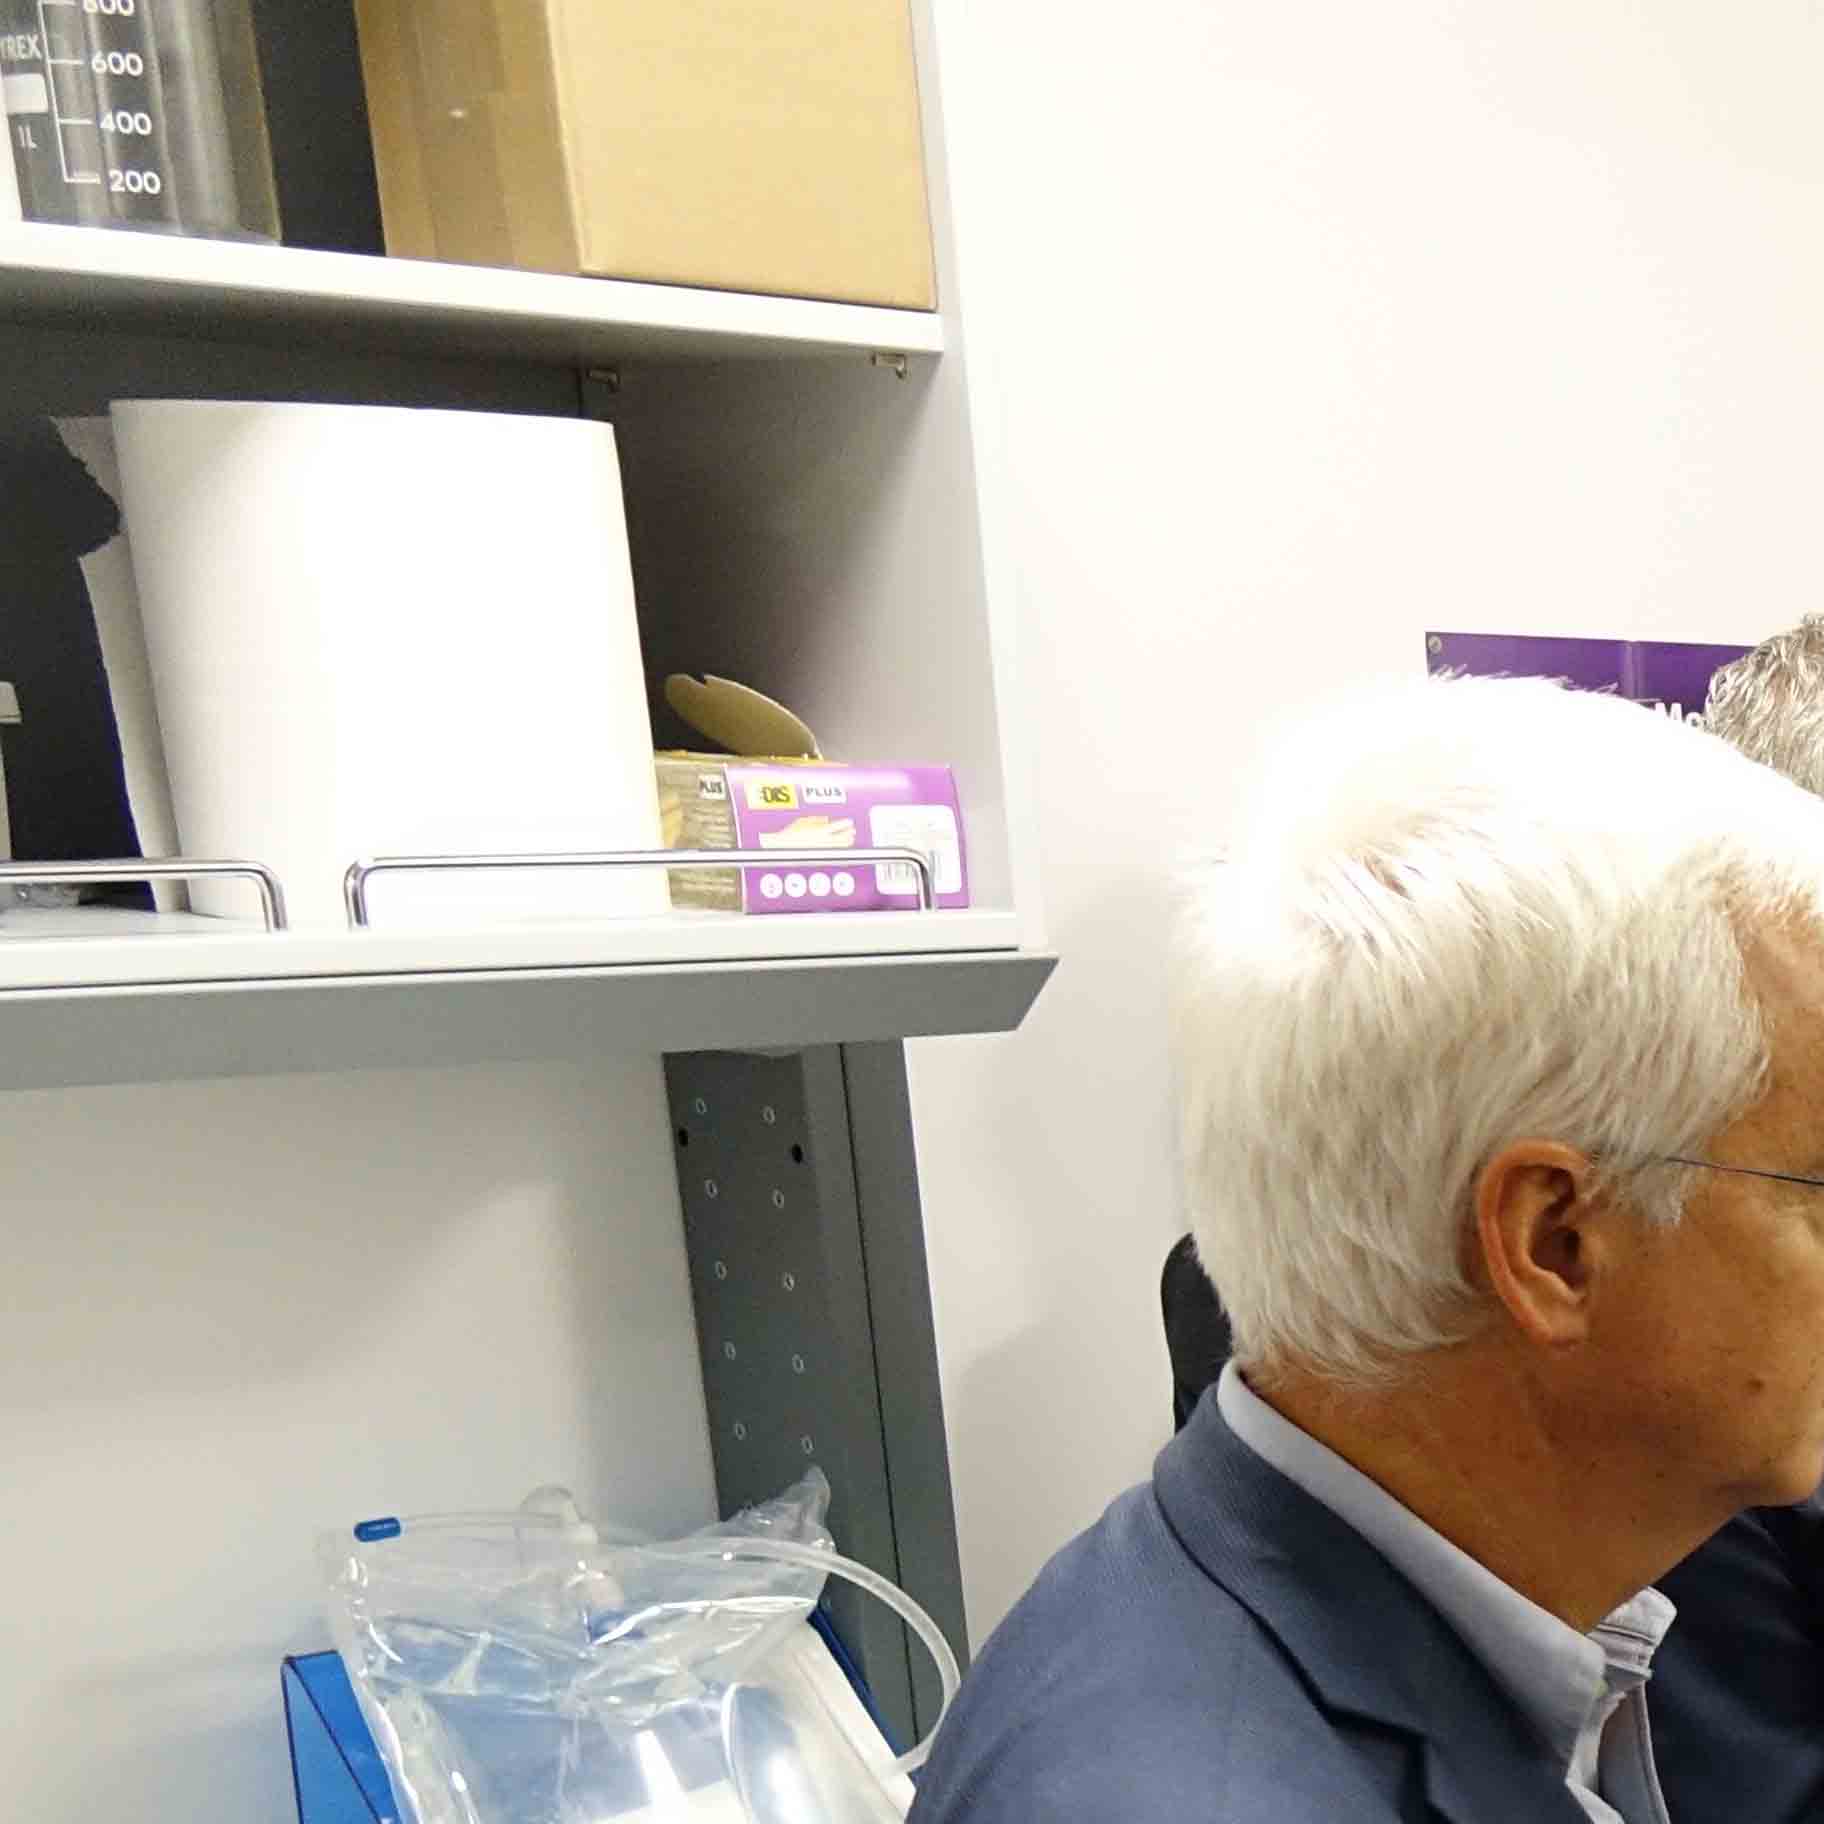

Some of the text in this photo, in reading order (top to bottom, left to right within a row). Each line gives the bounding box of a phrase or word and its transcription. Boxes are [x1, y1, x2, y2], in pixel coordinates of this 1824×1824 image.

[91, 51, 143, 76] 600
[100, 111, 152, 135] 400
[109, 169, 161, 194] 200
[806, 786, 842, 798] PLUS
